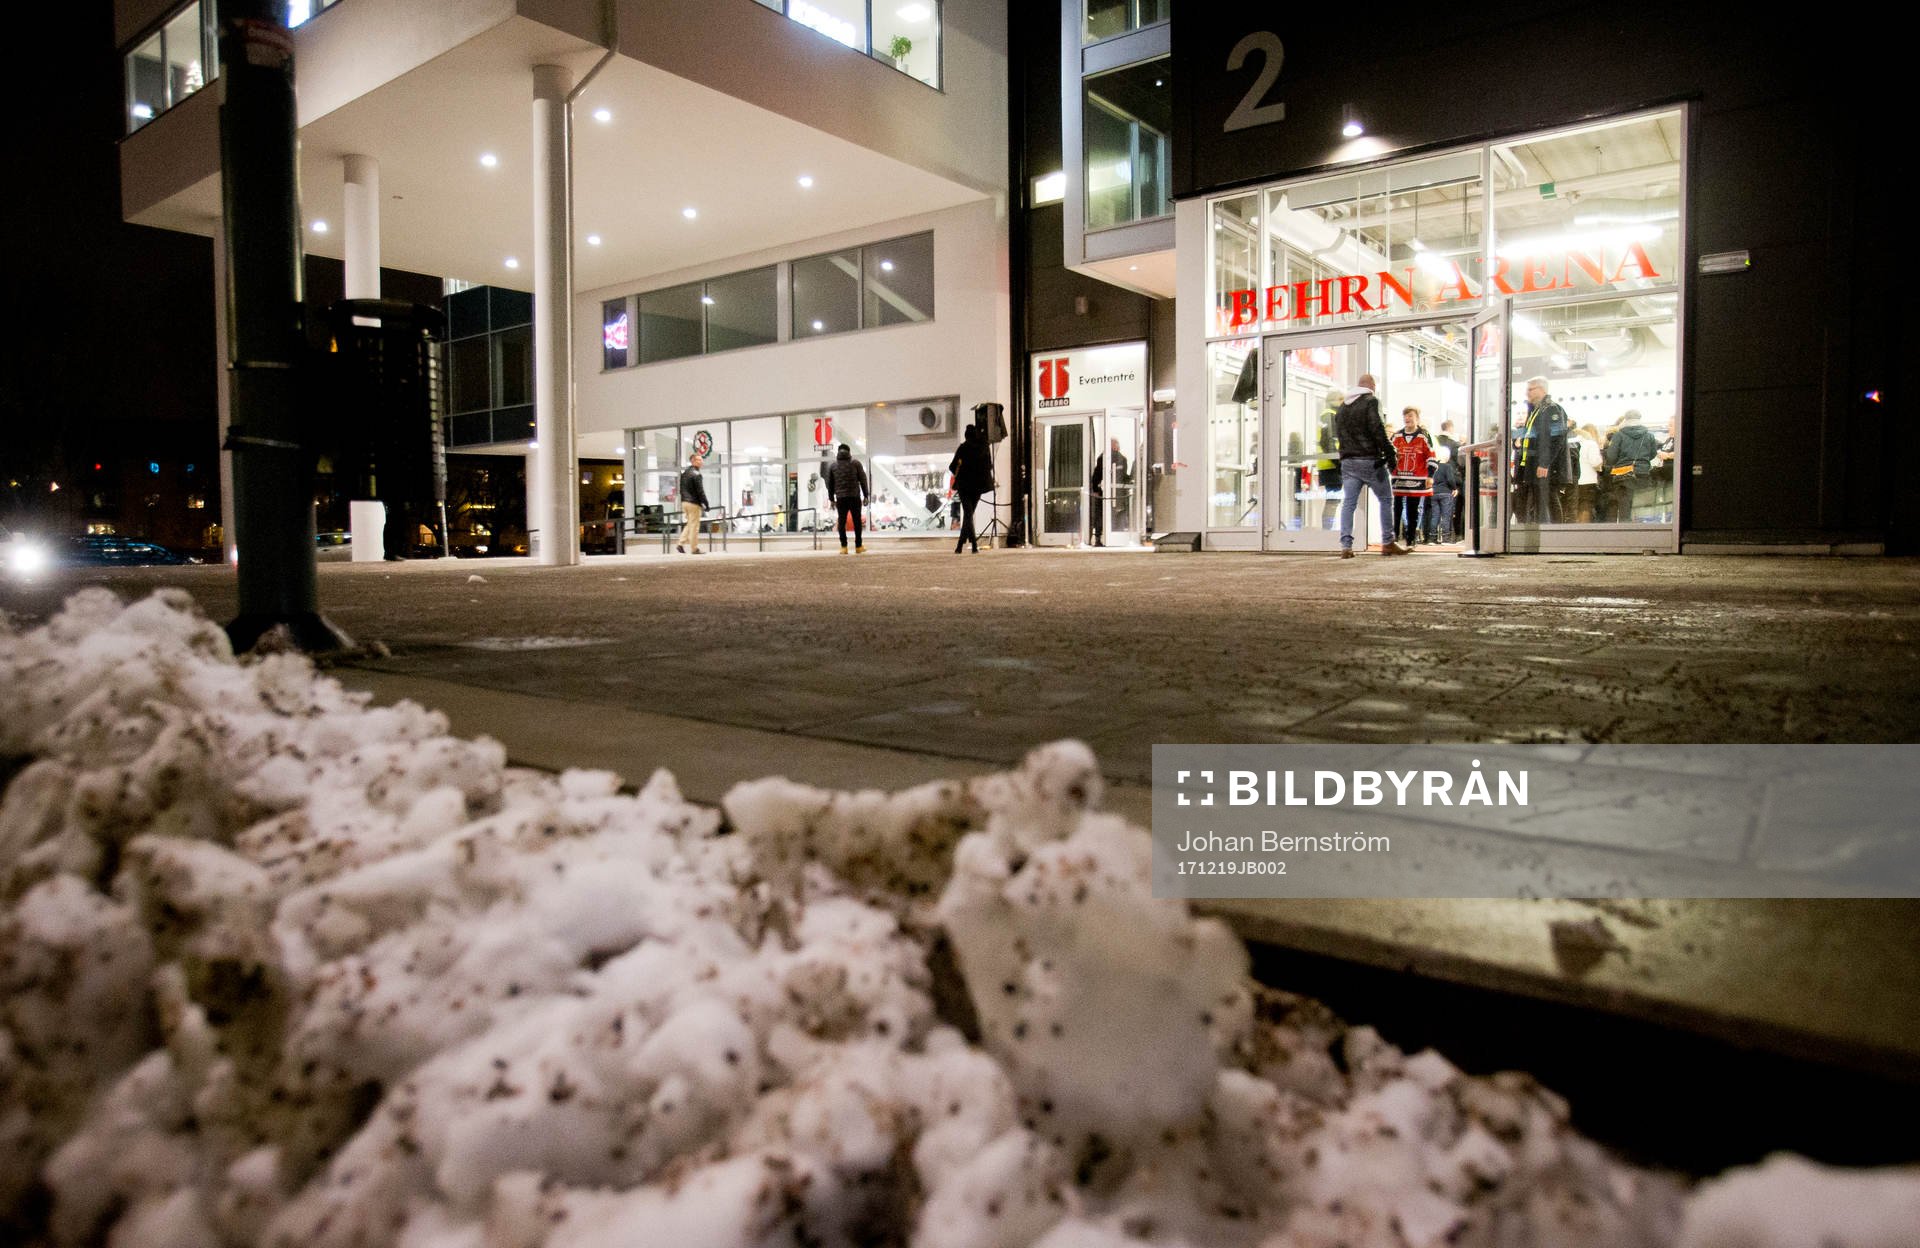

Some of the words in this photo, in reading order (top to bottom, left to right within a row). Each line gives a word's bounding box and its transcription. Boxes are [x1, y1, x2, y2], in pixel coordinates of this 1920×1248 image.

[1224, 31, 1285, 132] 2
[1228, 266, 1415, 327] BEHRN
[1433, 240, 1661, 303] ARENA
[1079, 371, 1135, 385] Evententré
